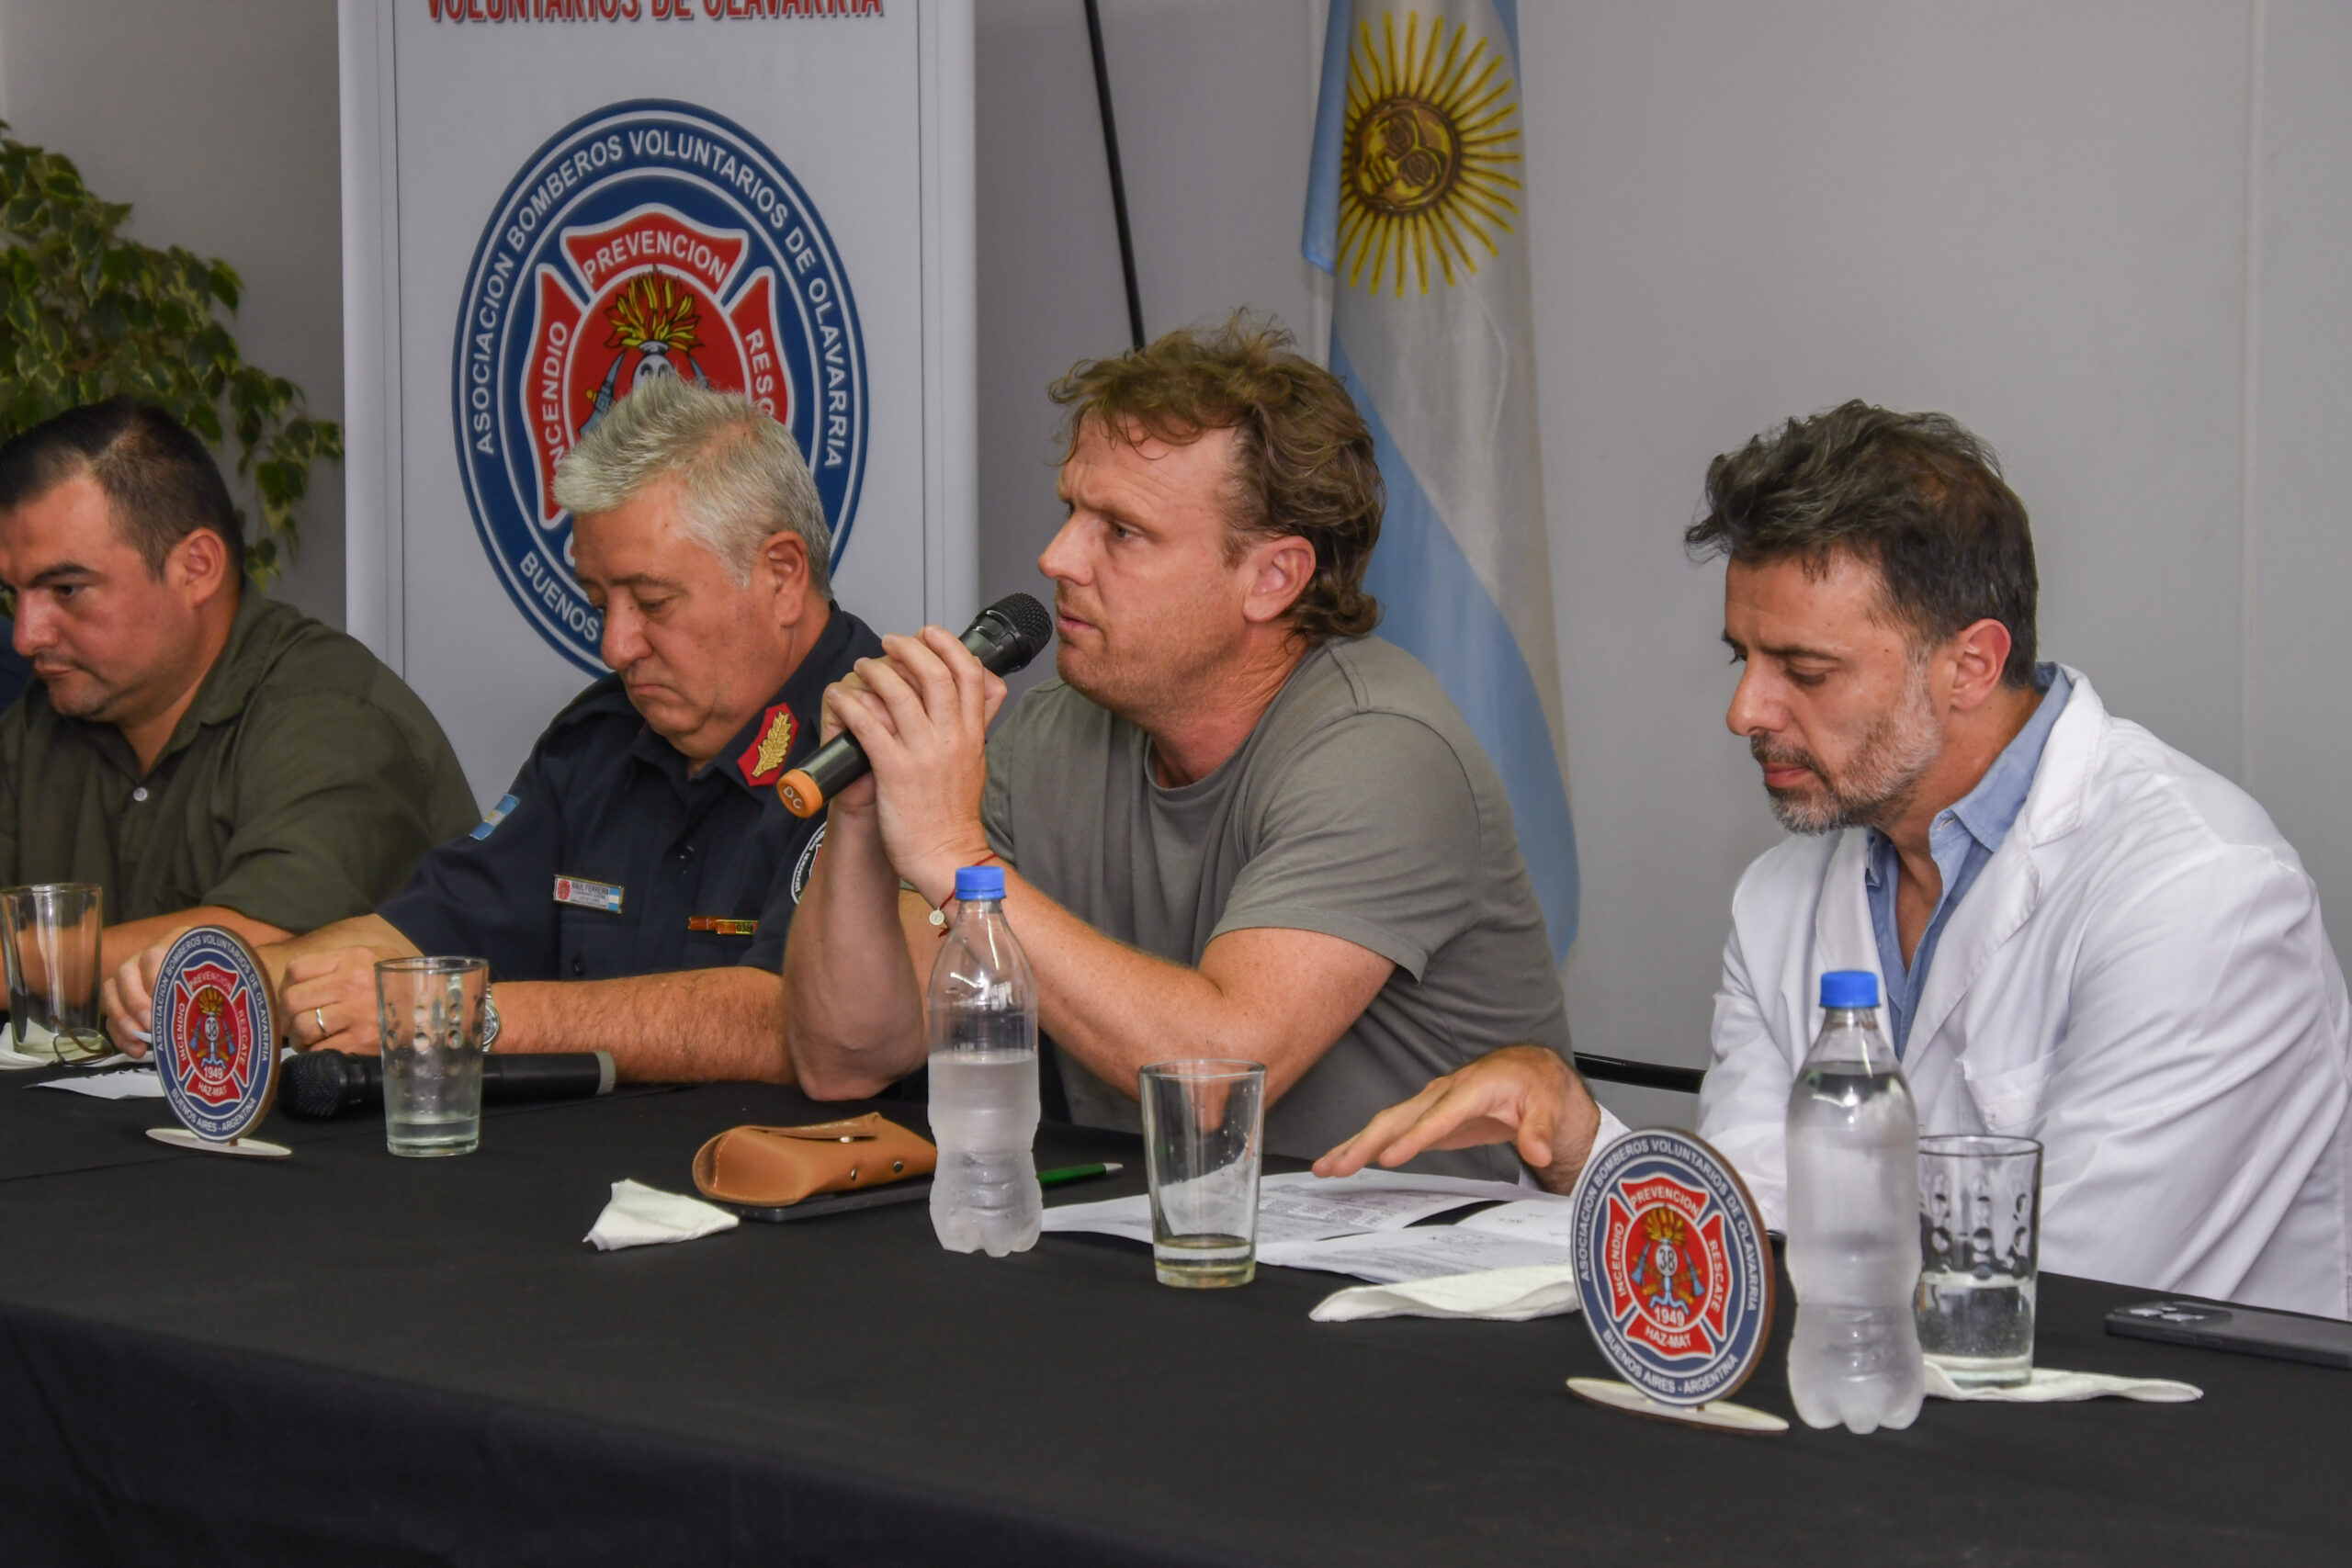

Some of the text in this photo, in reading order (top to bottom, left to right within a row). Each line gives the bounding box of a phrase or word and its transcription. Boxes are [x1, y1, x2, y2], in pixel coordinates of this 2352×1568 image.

[582, 230, 728, 285] PREVENCION
[471, 129, 847, 467] ASOCIACION BOMBEROS VOLUNTARIOS DE OLAVARRIA
[542, 321, 568, 468] NCENDIO
[519, 550, 599, 642] BUENOS
[155, 934, 272, 1062] ASOCIACION BOMBEROS VOLUNTARIOS DE OLAVARRIA
[188, 970, 233, 993] PREVENCION
[175, 1001, 187, 1063] INCENDIO
[205, 1020, 219, 1038] 38
[237, 1009, 249, 1067] RESCATE
[198, 1081, 228, 1097] HAZ-MAT
[203, 1065, 224, 1080] 1949
[171, 1088, 197, 1124] BUENOS
[196, 1114, 218, 1133] AIRES
[221, 1096, 257, 1133] ARGENTINA
[1577, 1137, 1762, 1313] ASOCIACION BOMBEROS VOLUNTARIOS DE OLAVARRIA
[1629, 1185, 1701, 1219] PREVENCION
[1611, 1221, 1627, 1298] INCENDIO
[1657, 1247, 1677, 1271] 38
[1709, 1238, 1725, 1314] RESCATE
[1644, 1325, 1692, 1349] HAZ-MAT
[1654, 1305, 1686, 1327] 1949
[1601, 1328, 1645, 1380] BUENOS
[1643, 1366, 1677, 1395] AIRES
[1682, 1355, 1740, 1395] ARGENTINA
